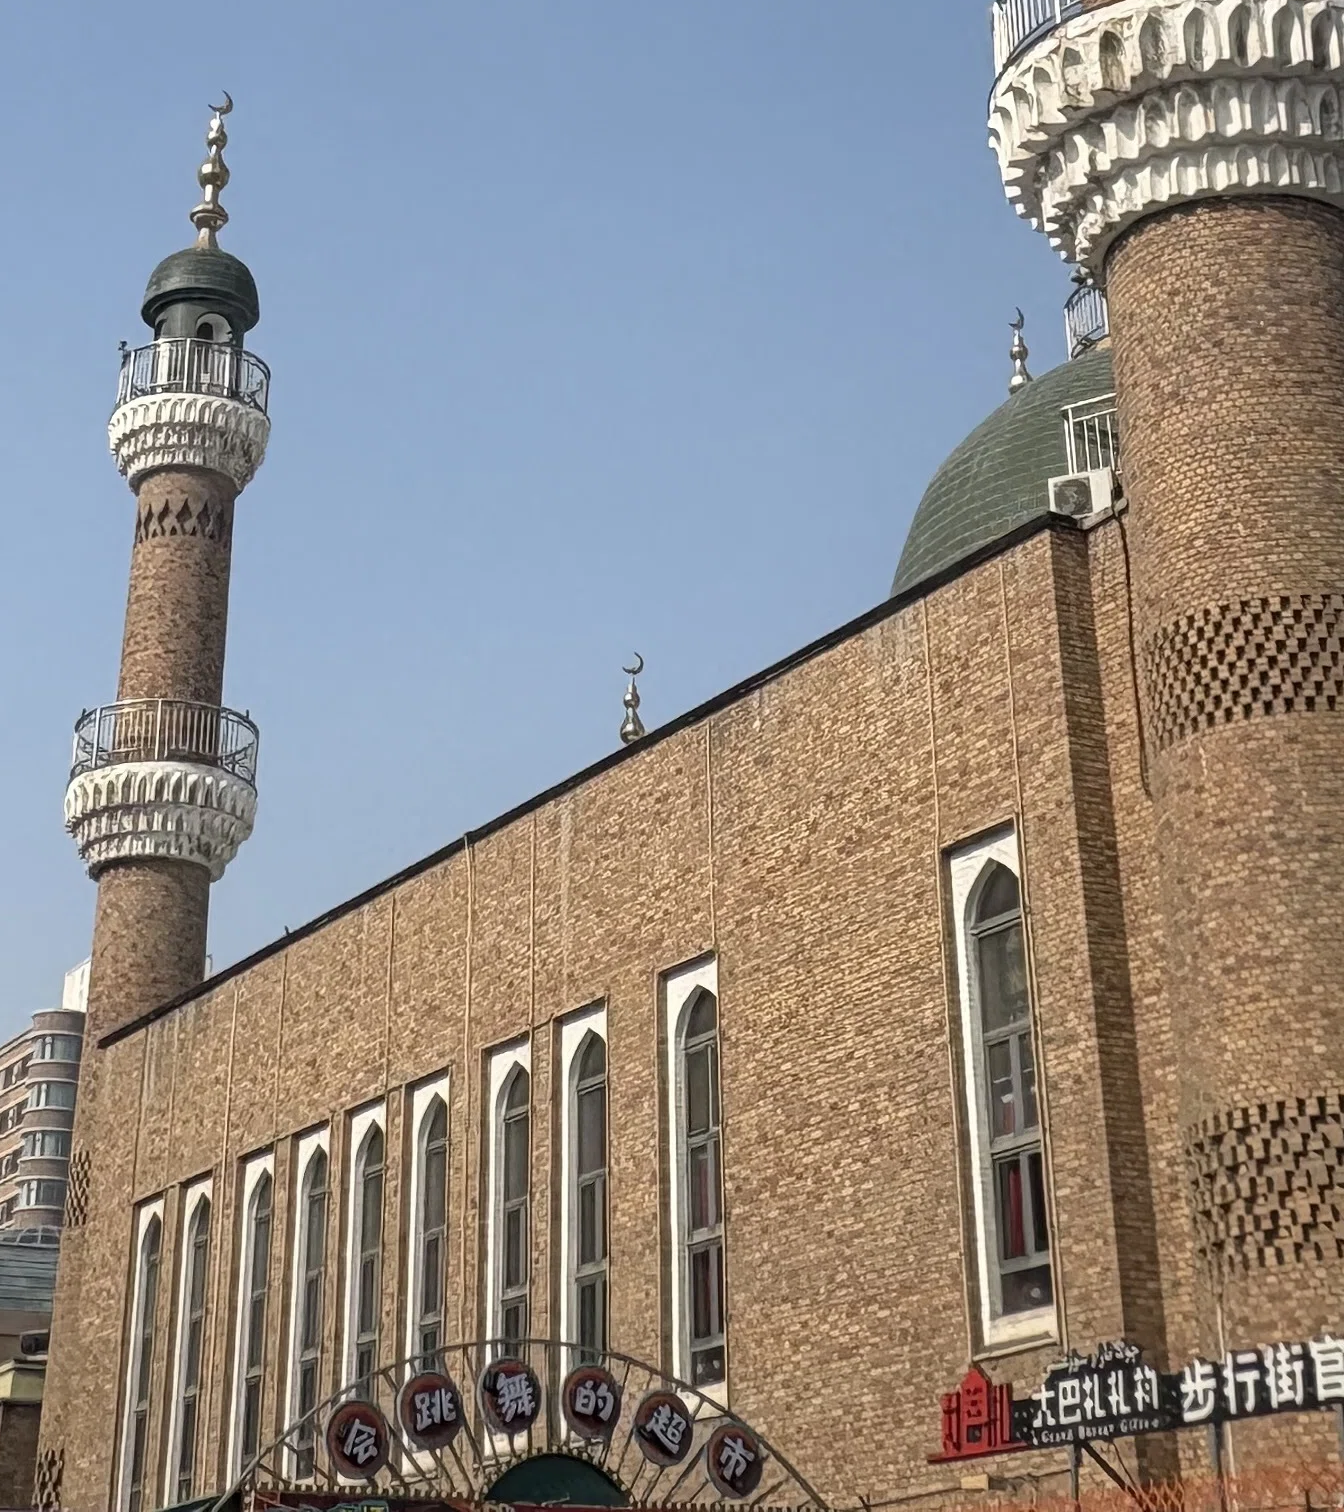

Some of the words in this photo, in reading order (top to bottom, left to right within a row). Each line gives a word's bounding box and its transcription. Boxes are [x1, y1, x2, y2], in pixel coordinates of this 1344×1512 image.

[341, 1372, 755, 1480] 会跳舞的超市
